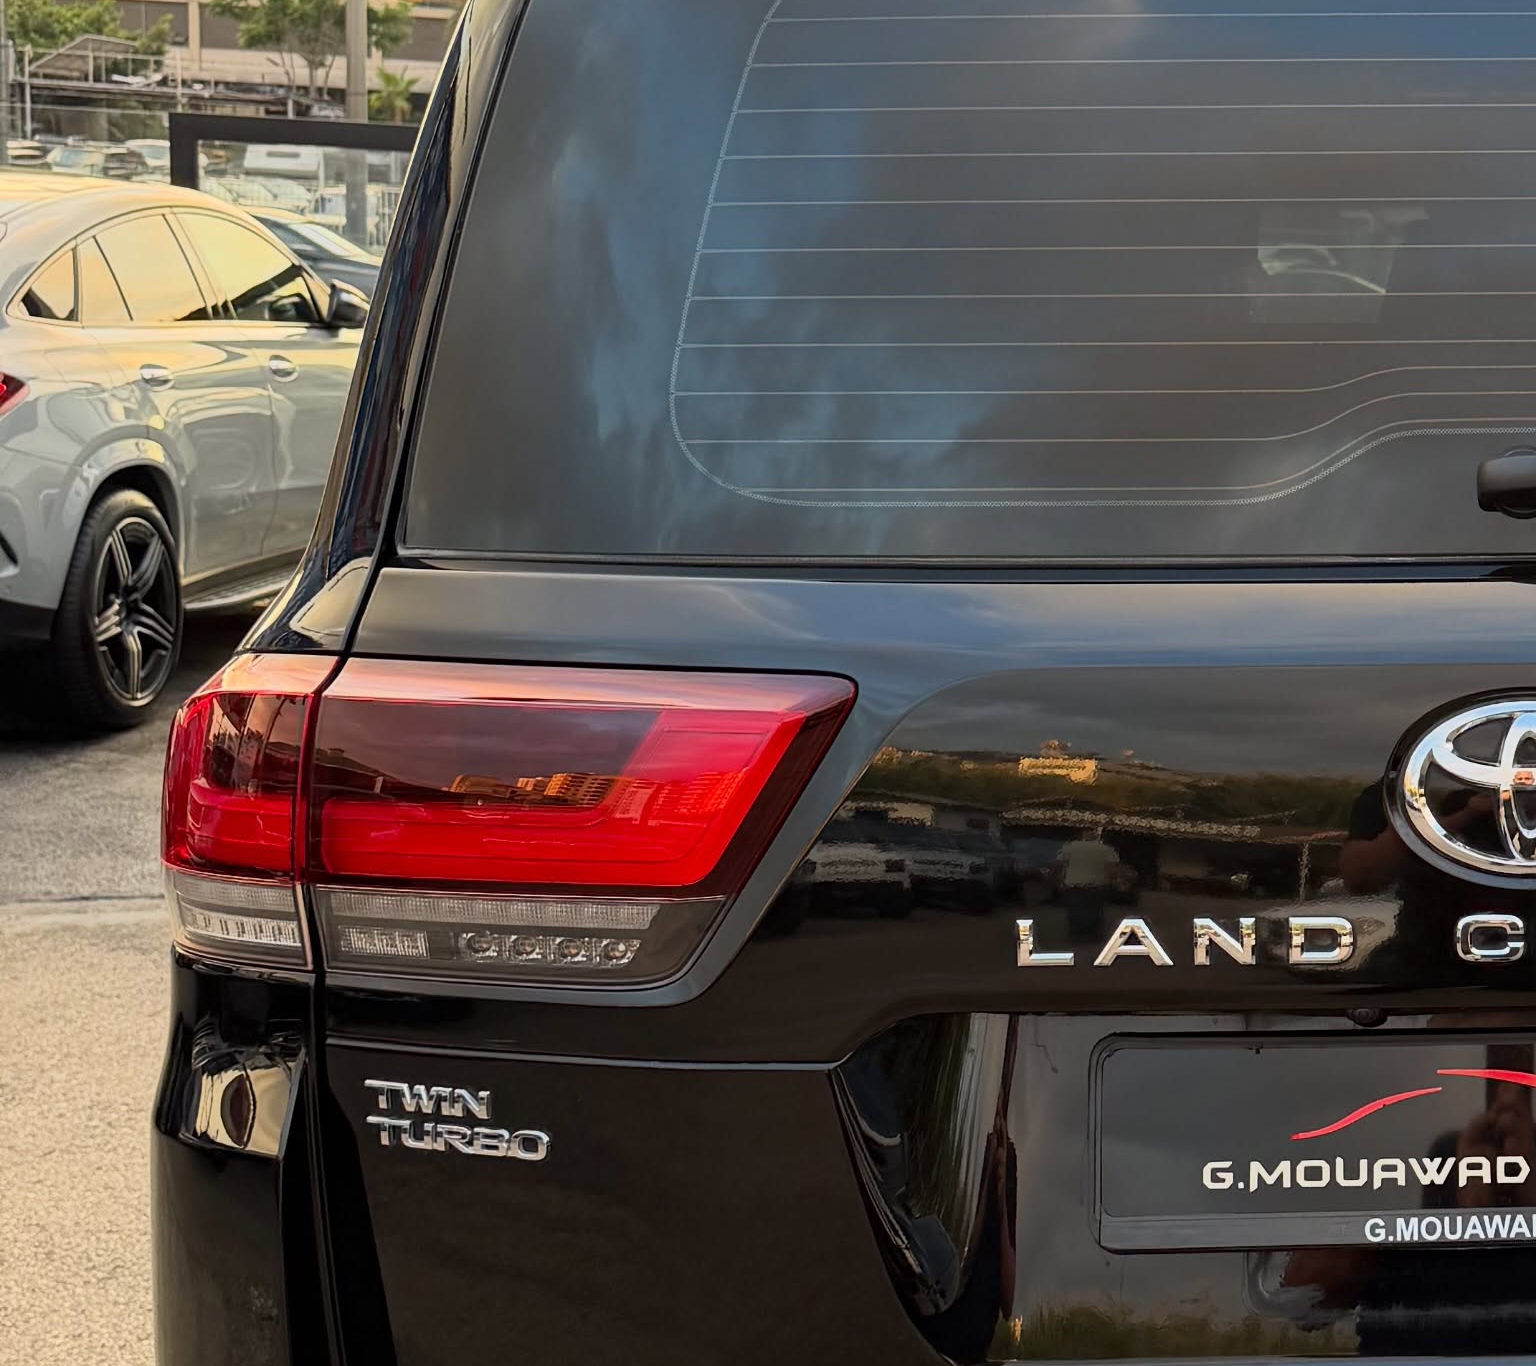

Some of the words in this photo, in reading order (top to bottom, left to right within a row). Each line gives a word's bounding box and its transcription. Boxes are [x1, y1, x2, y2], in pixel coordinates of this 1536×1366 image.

[1014, 916, 1355, 967] LAND
[364, 1079, 492, 1119] TWIN
[366, 1116, 551, 1161] TURBO
[1202, 1154, 1530, 1192] G.MOUAWAD
